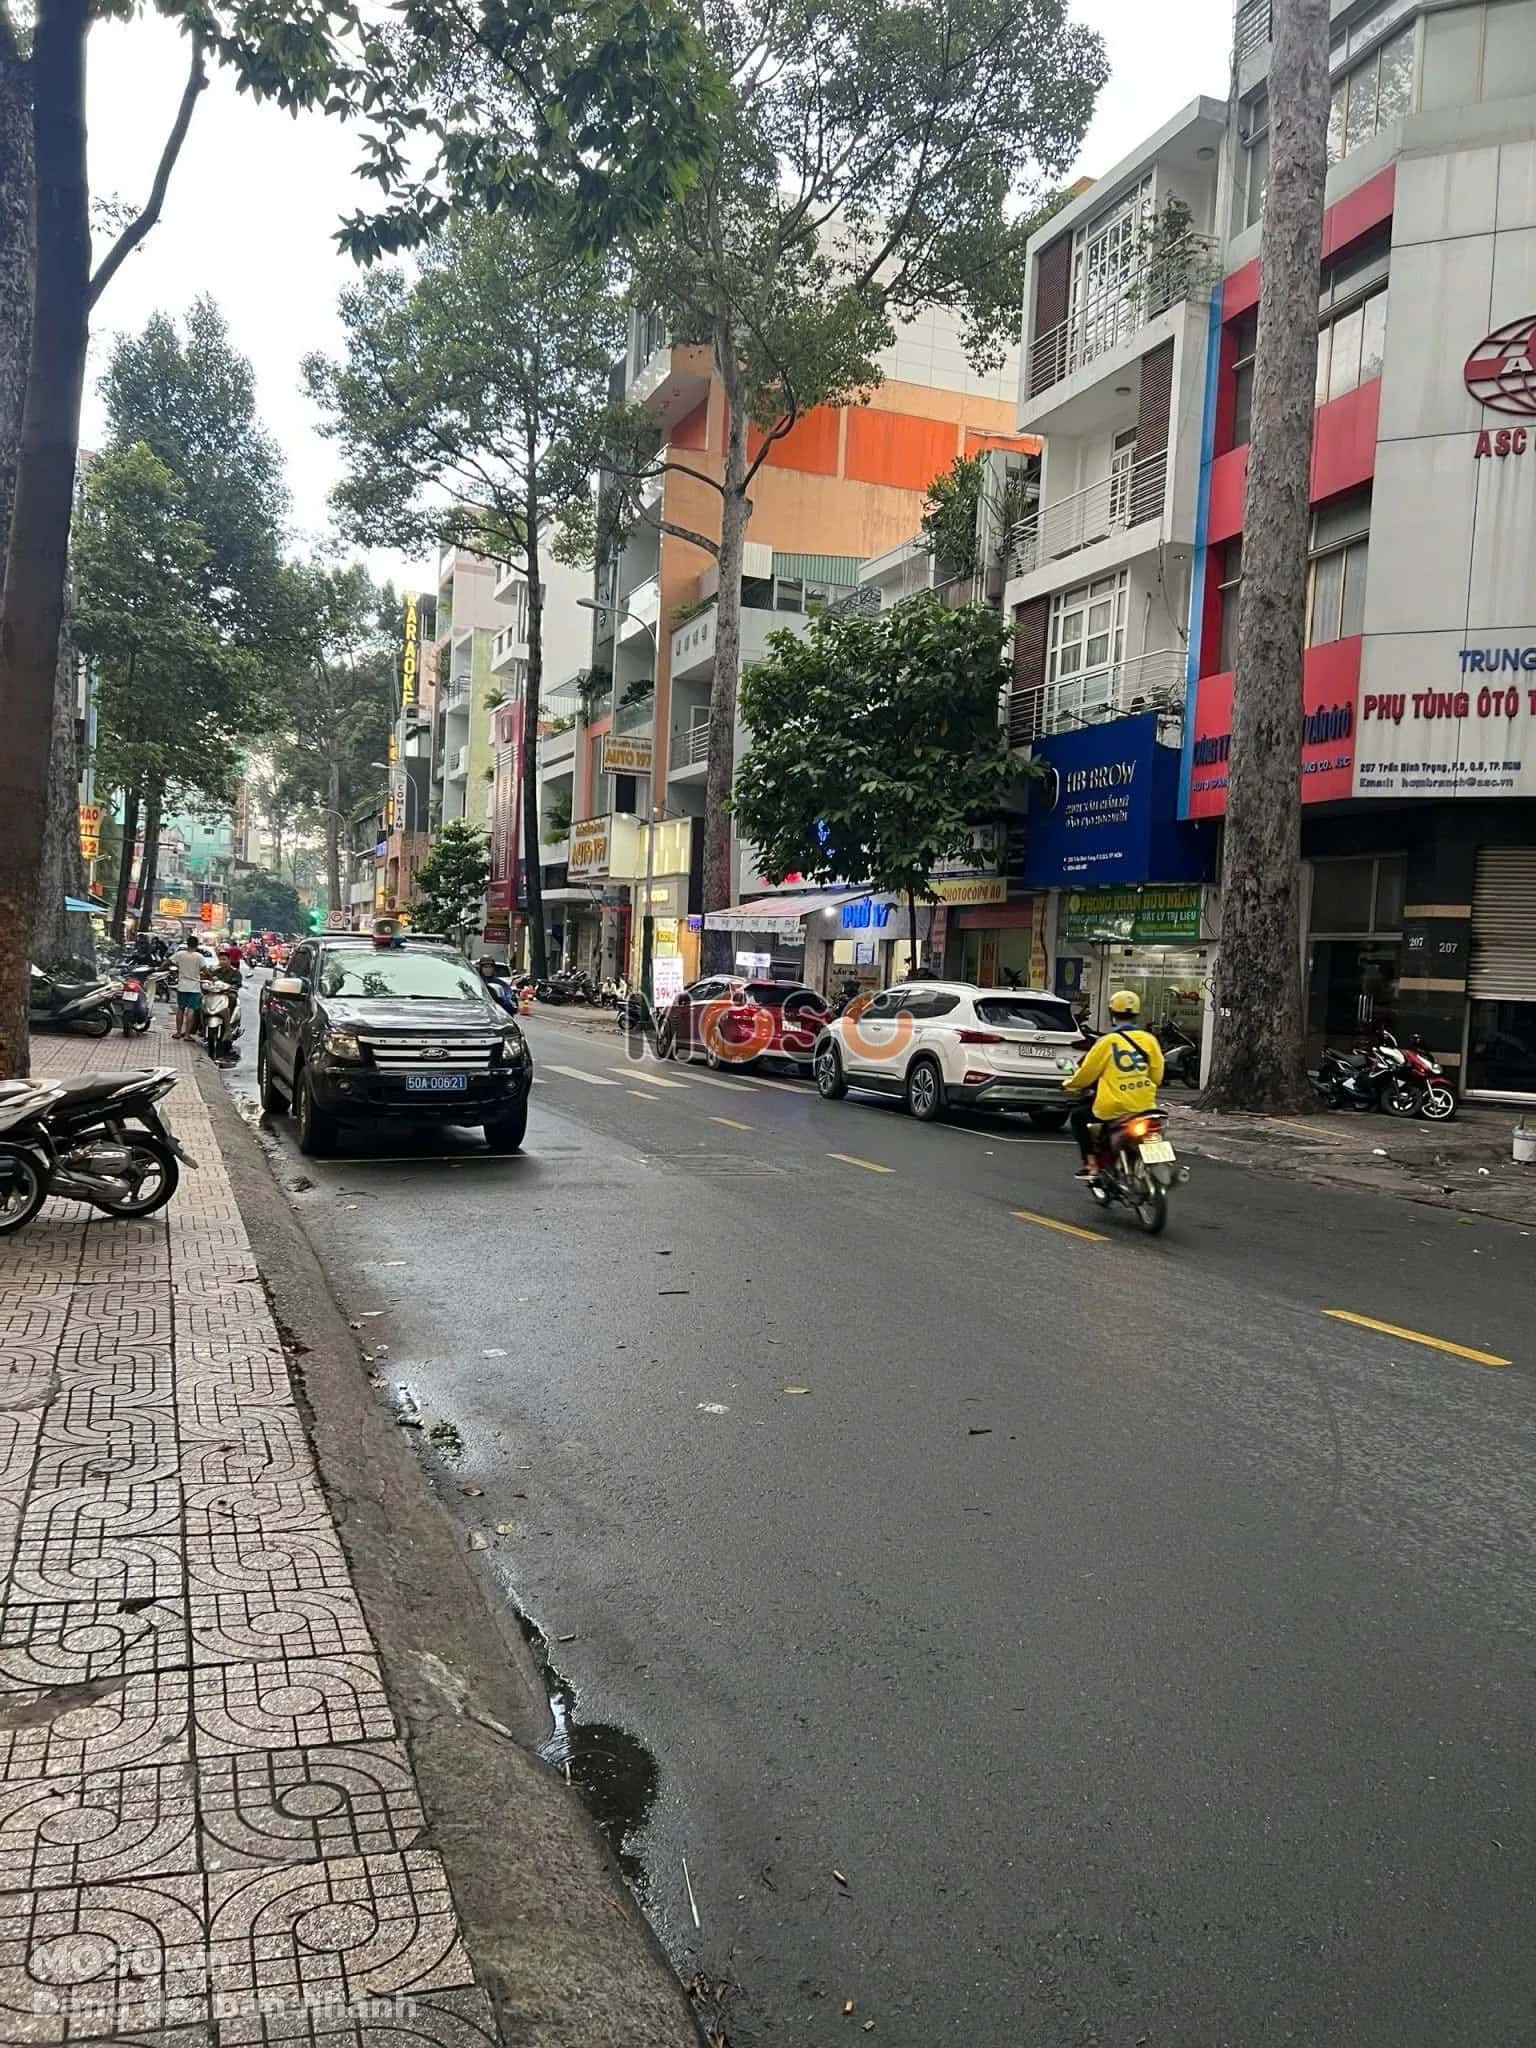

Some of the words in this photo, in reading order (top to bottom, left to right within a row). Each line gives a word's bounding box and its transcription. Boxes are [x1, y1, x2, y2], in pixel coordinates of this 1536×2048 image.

[1474, 426, 1527, 460] ASC
[403, 591, 418, 706] KARAOKE
[1459, 647, 1536, 673] TRUNG
[1363, 693, 1407, 726] PHỤ
[1412, 687, 1470, 720] TÙNG
[1477, 685, 1519, 719] ÔTÔ
[1089, 759, 1137, 789] BROW
[1409, 936, 1424, 947] 207
[1440, 942, 1458, 953] 207
[408, 1077, 428, 1089] 50A
